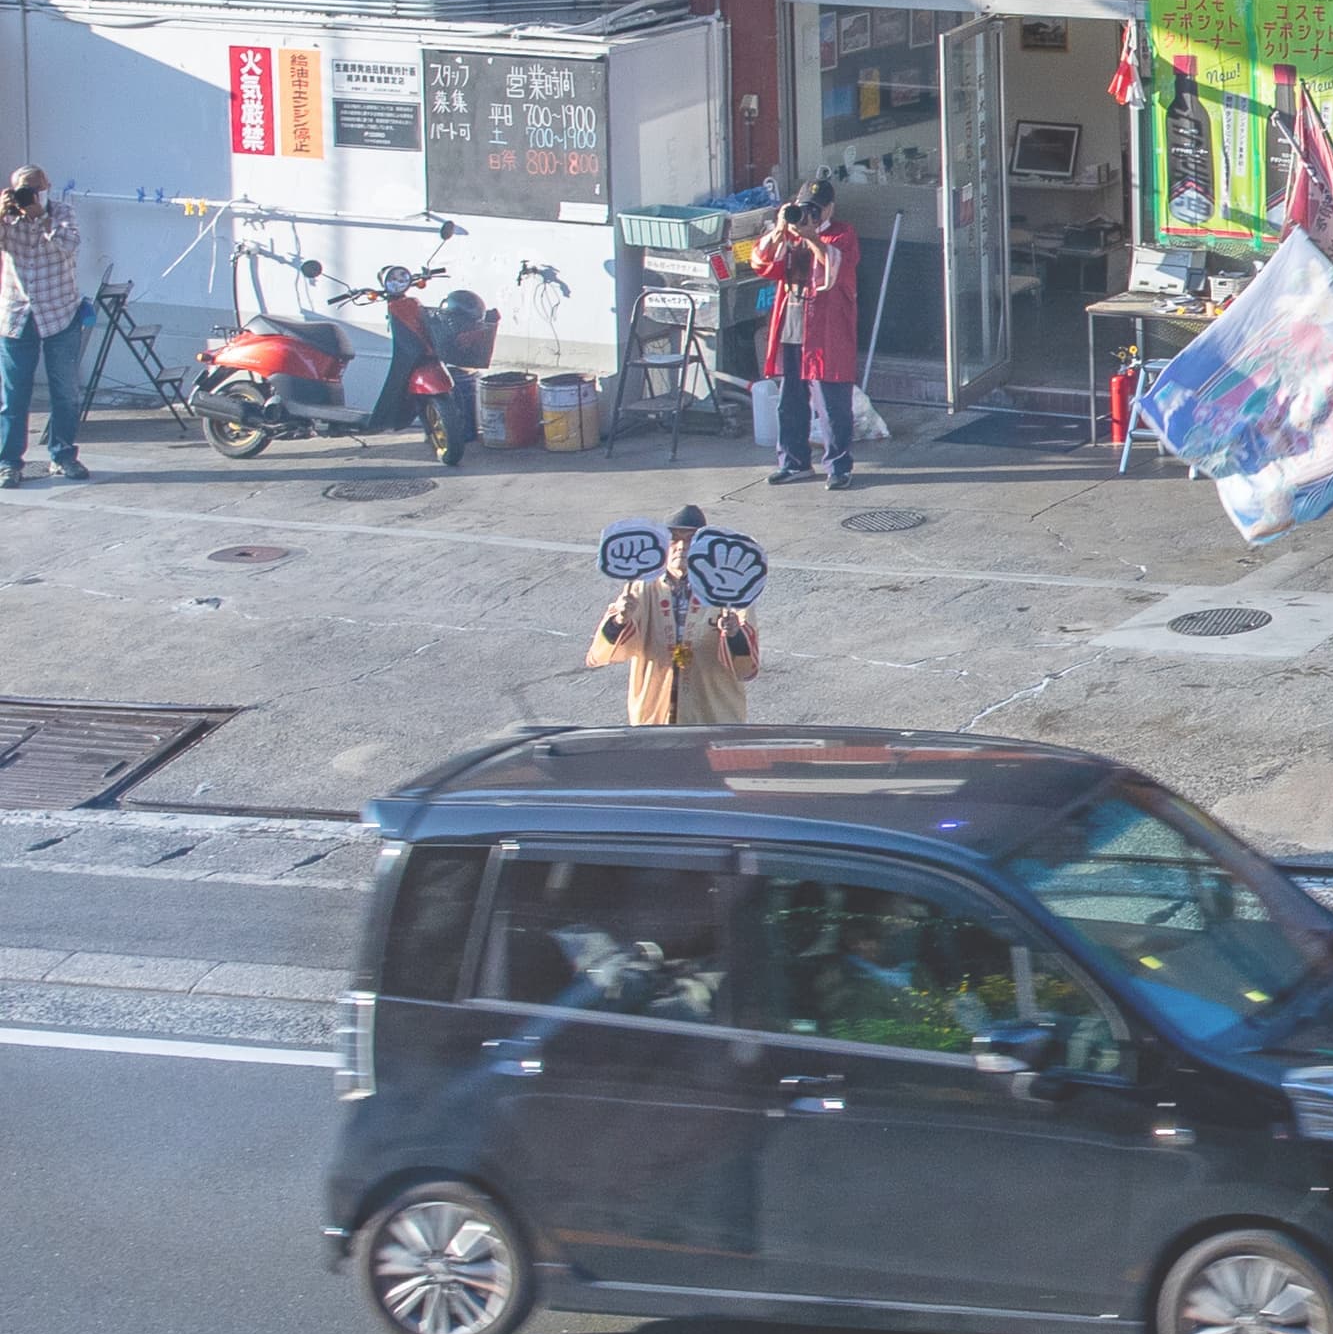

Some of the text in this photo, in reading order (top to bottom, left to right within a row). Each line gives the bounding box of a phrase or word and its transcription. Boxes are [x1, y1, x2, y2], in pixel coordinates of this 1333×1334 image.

[1162, 12, 1239, 33] デポジット
[1276, 5, 1326, 23] コスモ
[1163, 32, 1242, 51] クリーナー
[430, 63, 470, 88] スタッフ
[506, 64, 575, 100] 営業時間
[239, 49, 265, 152] 火気厳禁
[290, 53, 312, 154] 給油中エンジン停止
[432, 88, 468, 114] 募集
[488, 103, 514, 127] 平日
[430, 122, 471, 142] パート可
[488, 128, 508, 145] 土
[488, 149, 517, 171] 日祭
